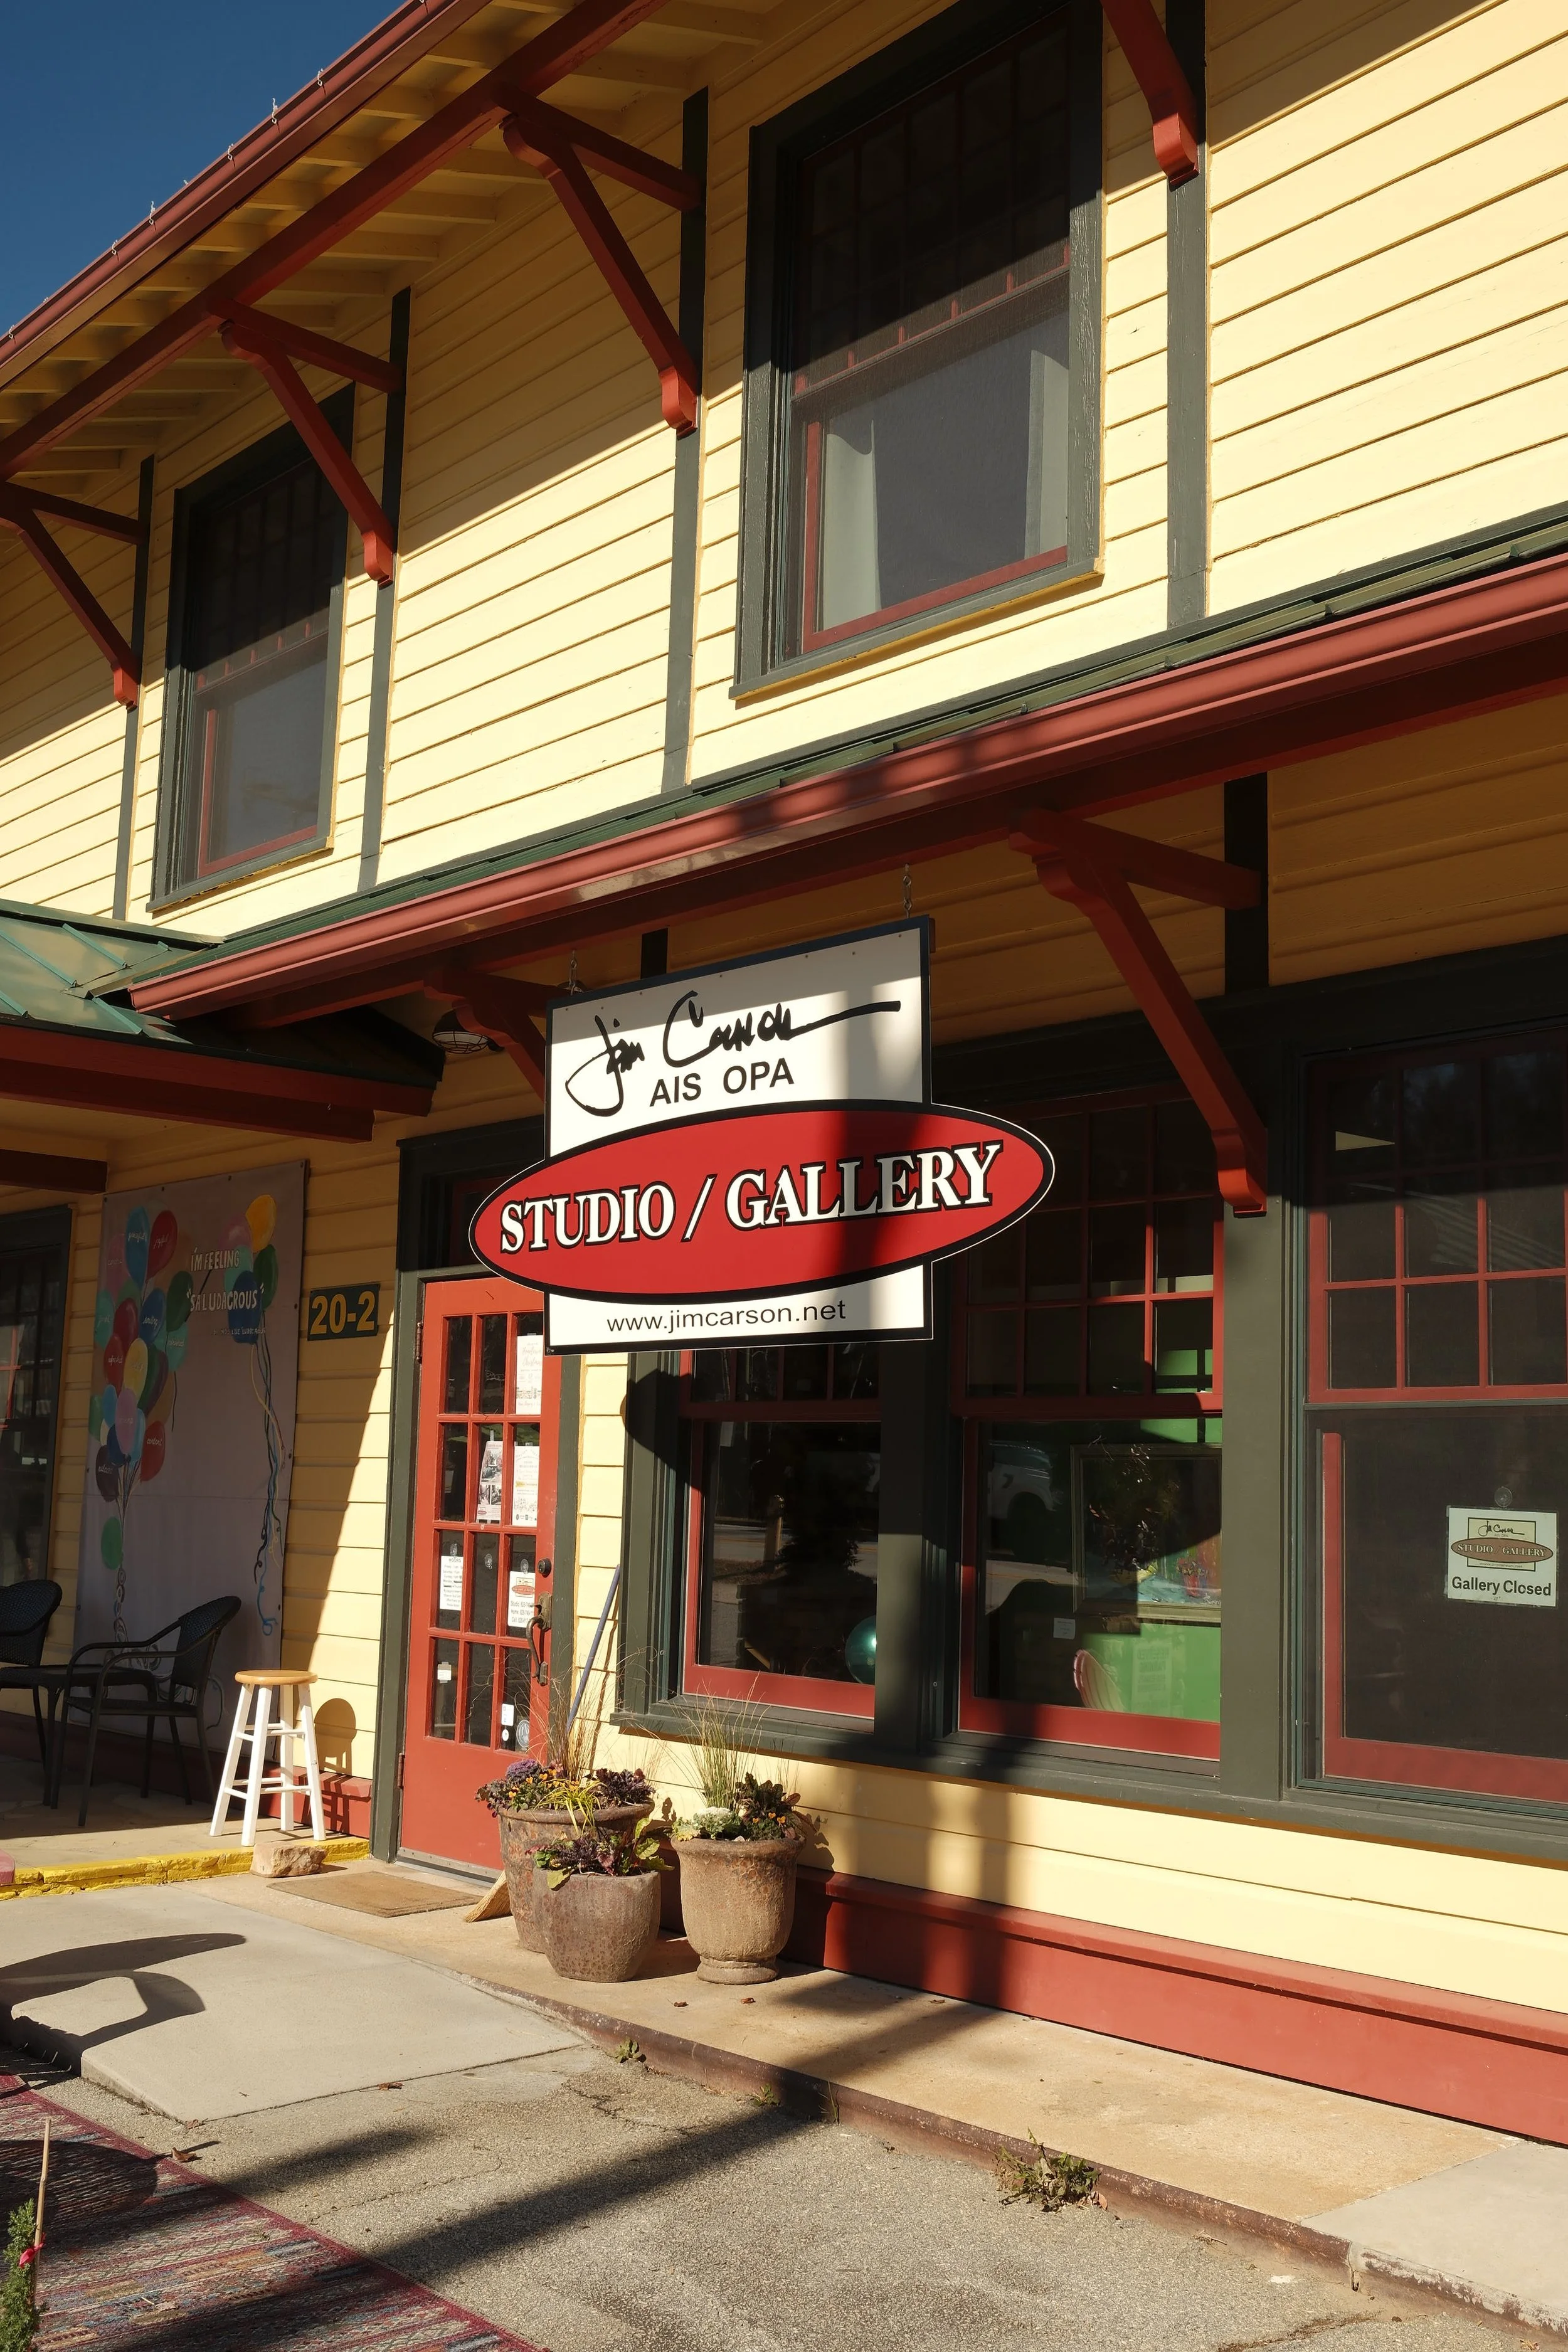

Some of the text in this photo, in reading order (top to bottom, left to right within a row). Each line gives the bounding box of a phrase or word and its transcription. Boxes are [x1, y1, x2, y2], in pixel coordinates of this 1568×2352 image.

[565, 1015, 645, 1117] Jim
[649, 1058, 795, 1107] AIS OPA
[501, 1185, 675, 1253] STUDIO
[726, 1143, 1002, 1231] GALLERY
[204, 1249, 240, 1271] FEELING
[310, 1290, 376, 1335] 20-2
[607, 1300, 846, 1334] www.jimcarson.net
[1457, 1544, 1493, 1554] STUDIO
[1502, 1547, 1547, 1557] GALLERY
[1451, 1576, 1552, 1596] Gallery Closed
